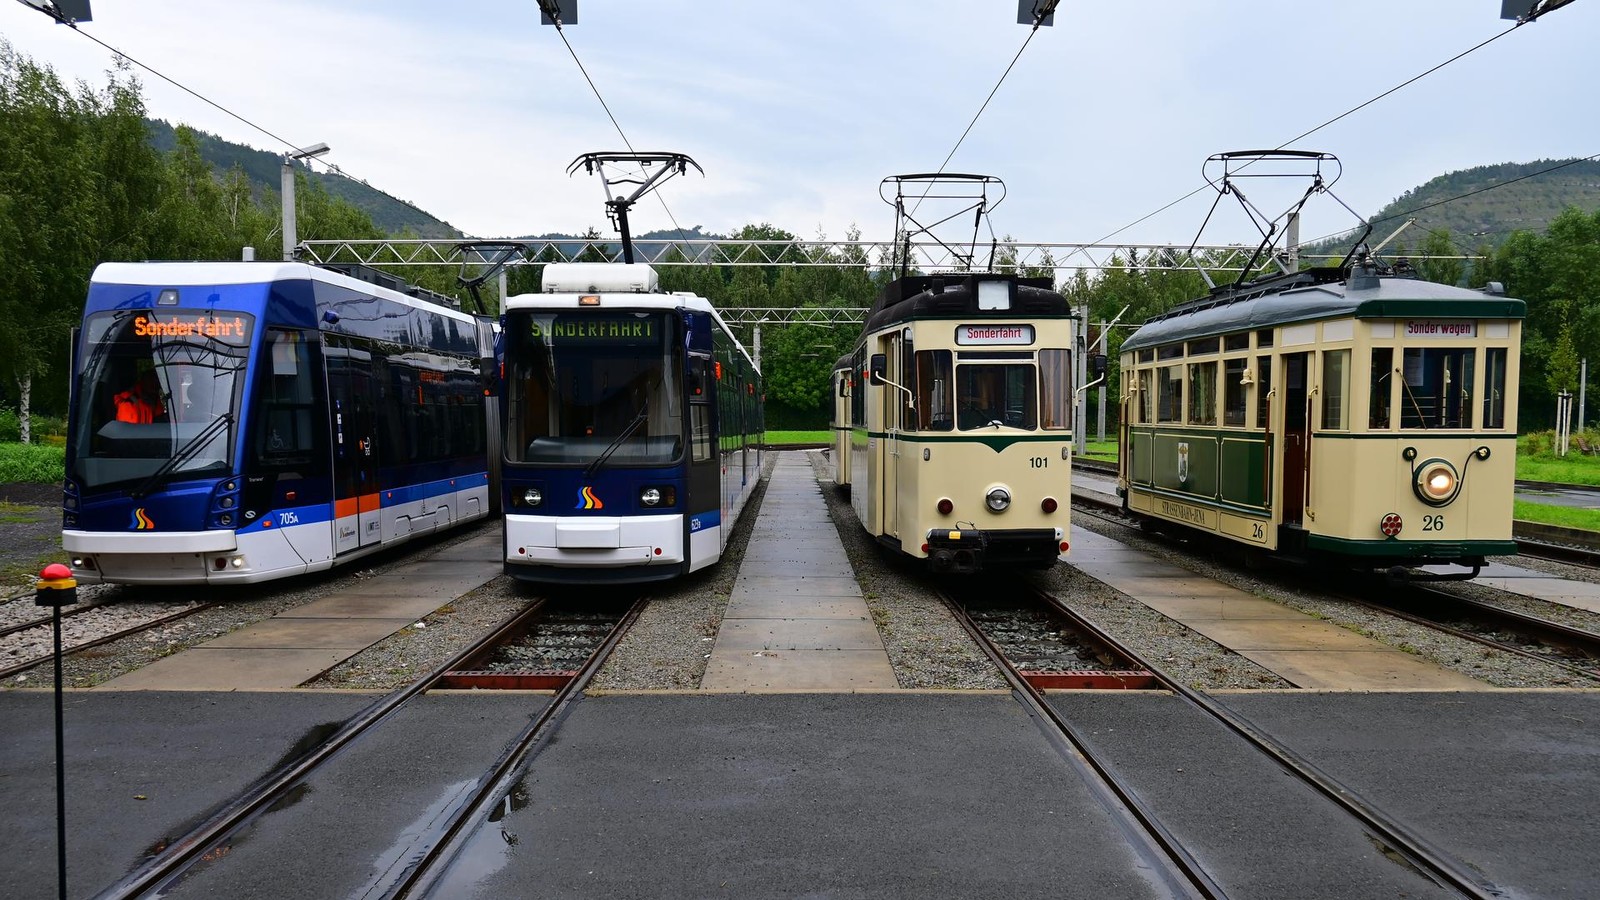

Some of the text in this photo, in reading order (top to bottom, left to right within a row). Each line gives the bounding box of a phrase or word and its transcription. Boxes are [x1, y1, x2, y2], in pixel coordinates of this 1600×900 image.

[134, 316, 243, 336] Sonderfahrt
[531, 321, 652, 337] SONDERFAHRT
[967, 327, 1022, 339] Sonderfahrt
[1029, 457, 1048, 468] 101
[279, 512, 298, 525] 705A
[1422, 515, 1444, 531] 26
[1252, 523, 1263, 539] 26
